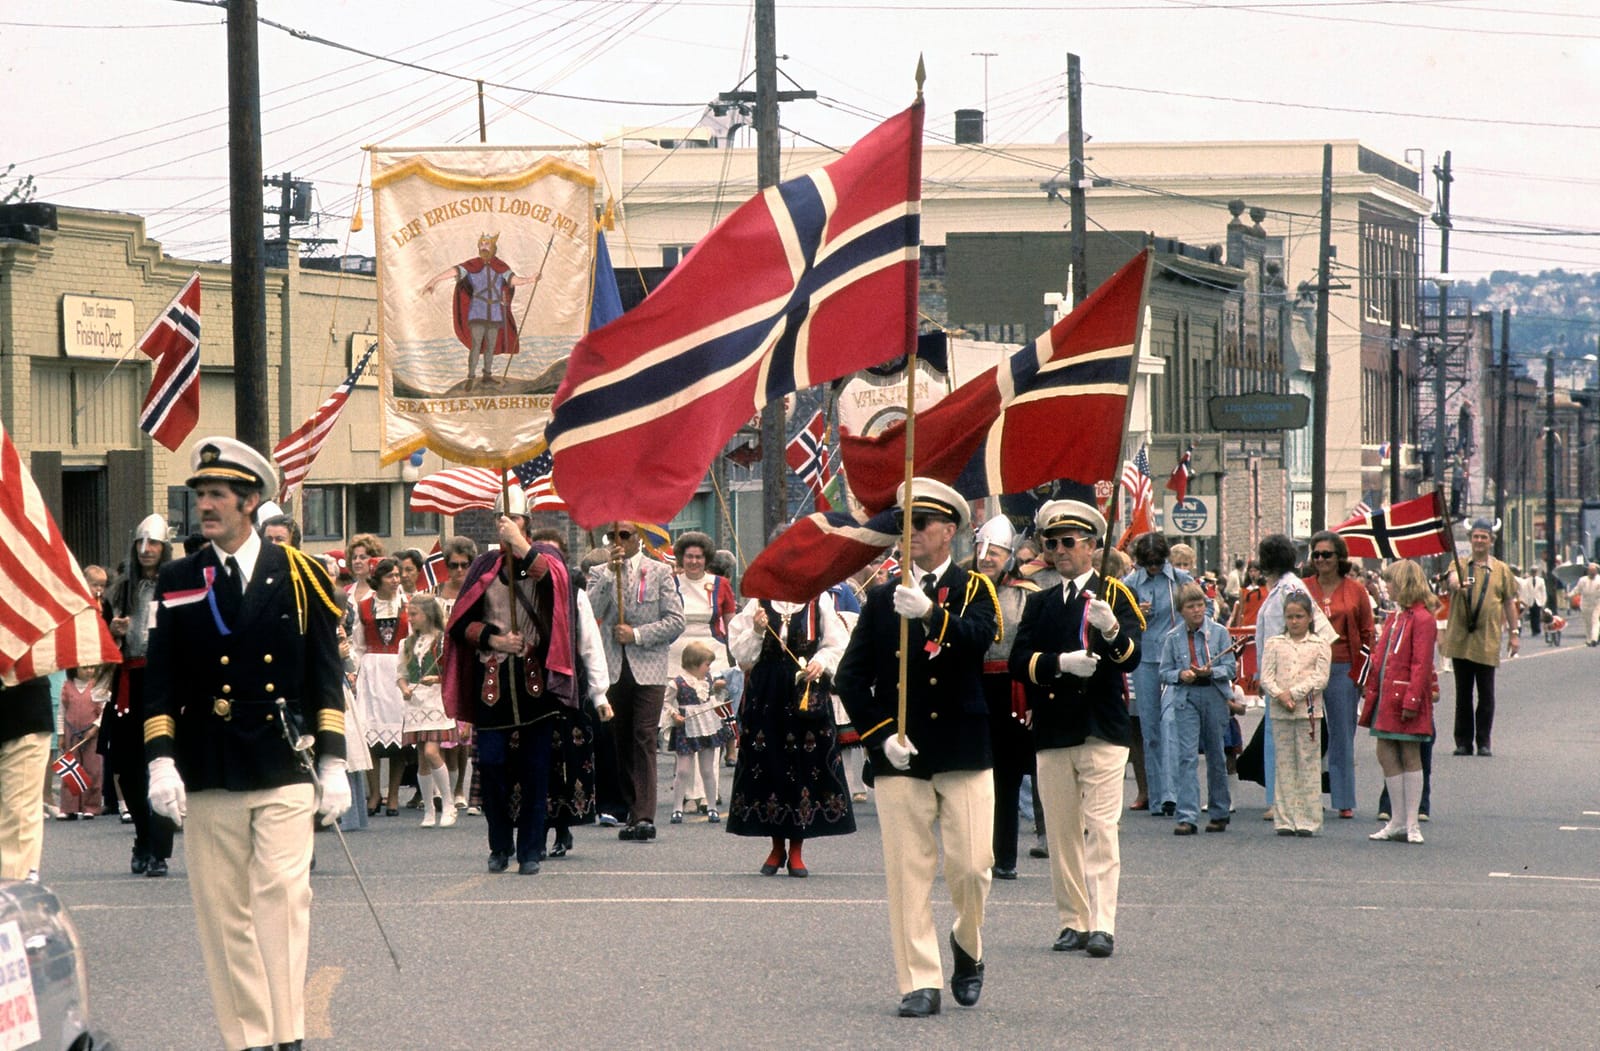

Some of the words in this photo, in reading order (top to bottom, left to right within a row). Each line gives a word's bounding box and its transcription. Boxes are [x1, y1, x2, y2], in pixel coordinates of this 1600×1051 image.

[391, 218, 423, 248] LEIF
[423, 196, 494, 227] ERIKSON
[499, 196, 551, 223] LODGE
[76, 320, 105, 354] Finishing
[475, 396, 553, 411] WASHING
